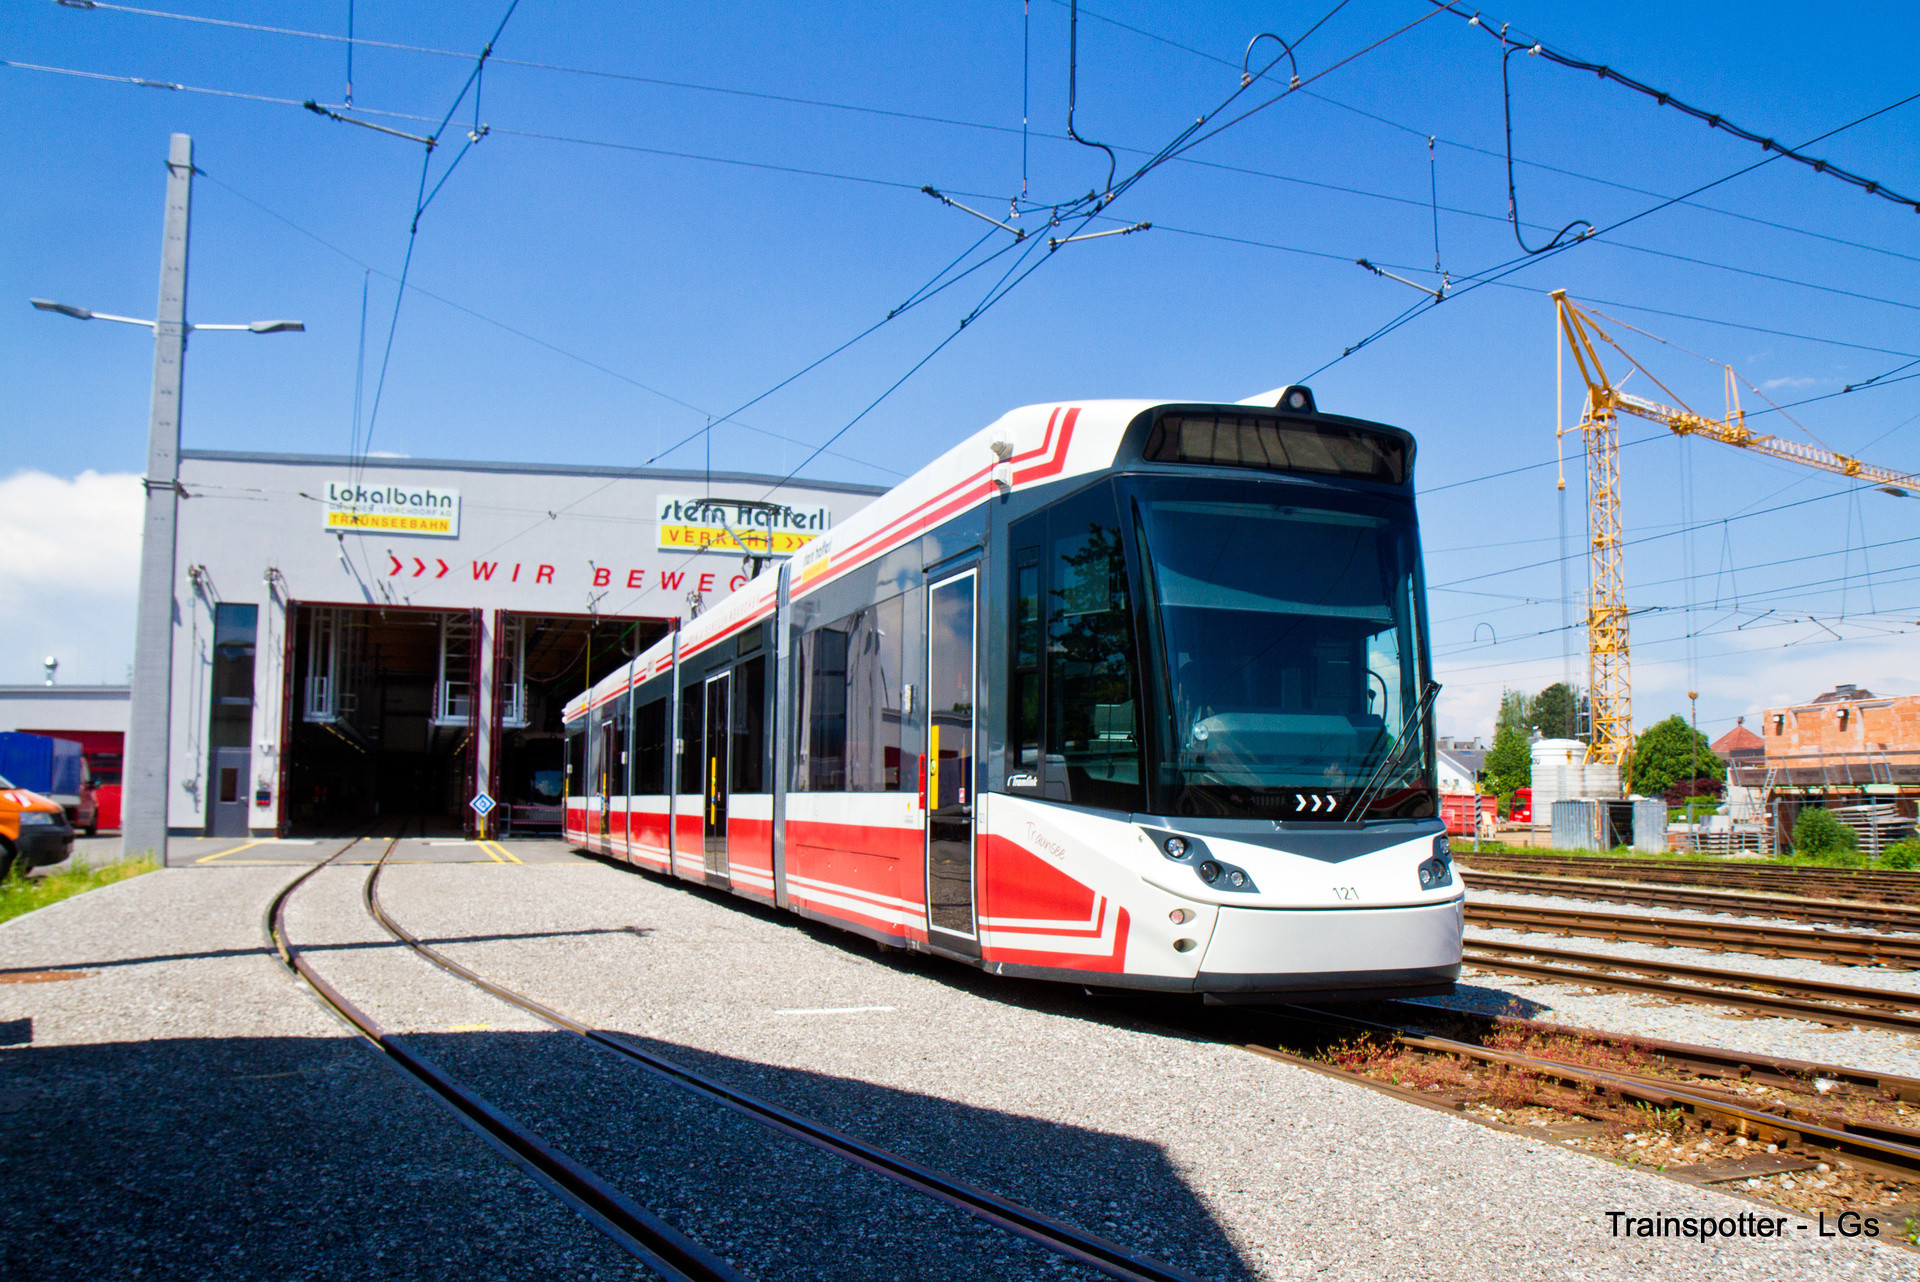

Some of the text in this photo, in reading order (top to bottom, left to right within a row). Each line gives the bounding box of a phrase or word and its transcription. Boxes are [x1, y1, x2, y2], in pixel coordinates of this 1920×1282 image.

[330, 483, 452, 508] Lokalbahn
[331, 515, 448, 530] TRAUNSEEBAHN
[661, 500, 824, 530] stern hafferl
[669, 529, 774, 548] VERKEHR
[472, 560, 556, 584] WIR
[1026, 821, 1066, 860] Traunsee
[1332, 886, 1360, 901] 121
